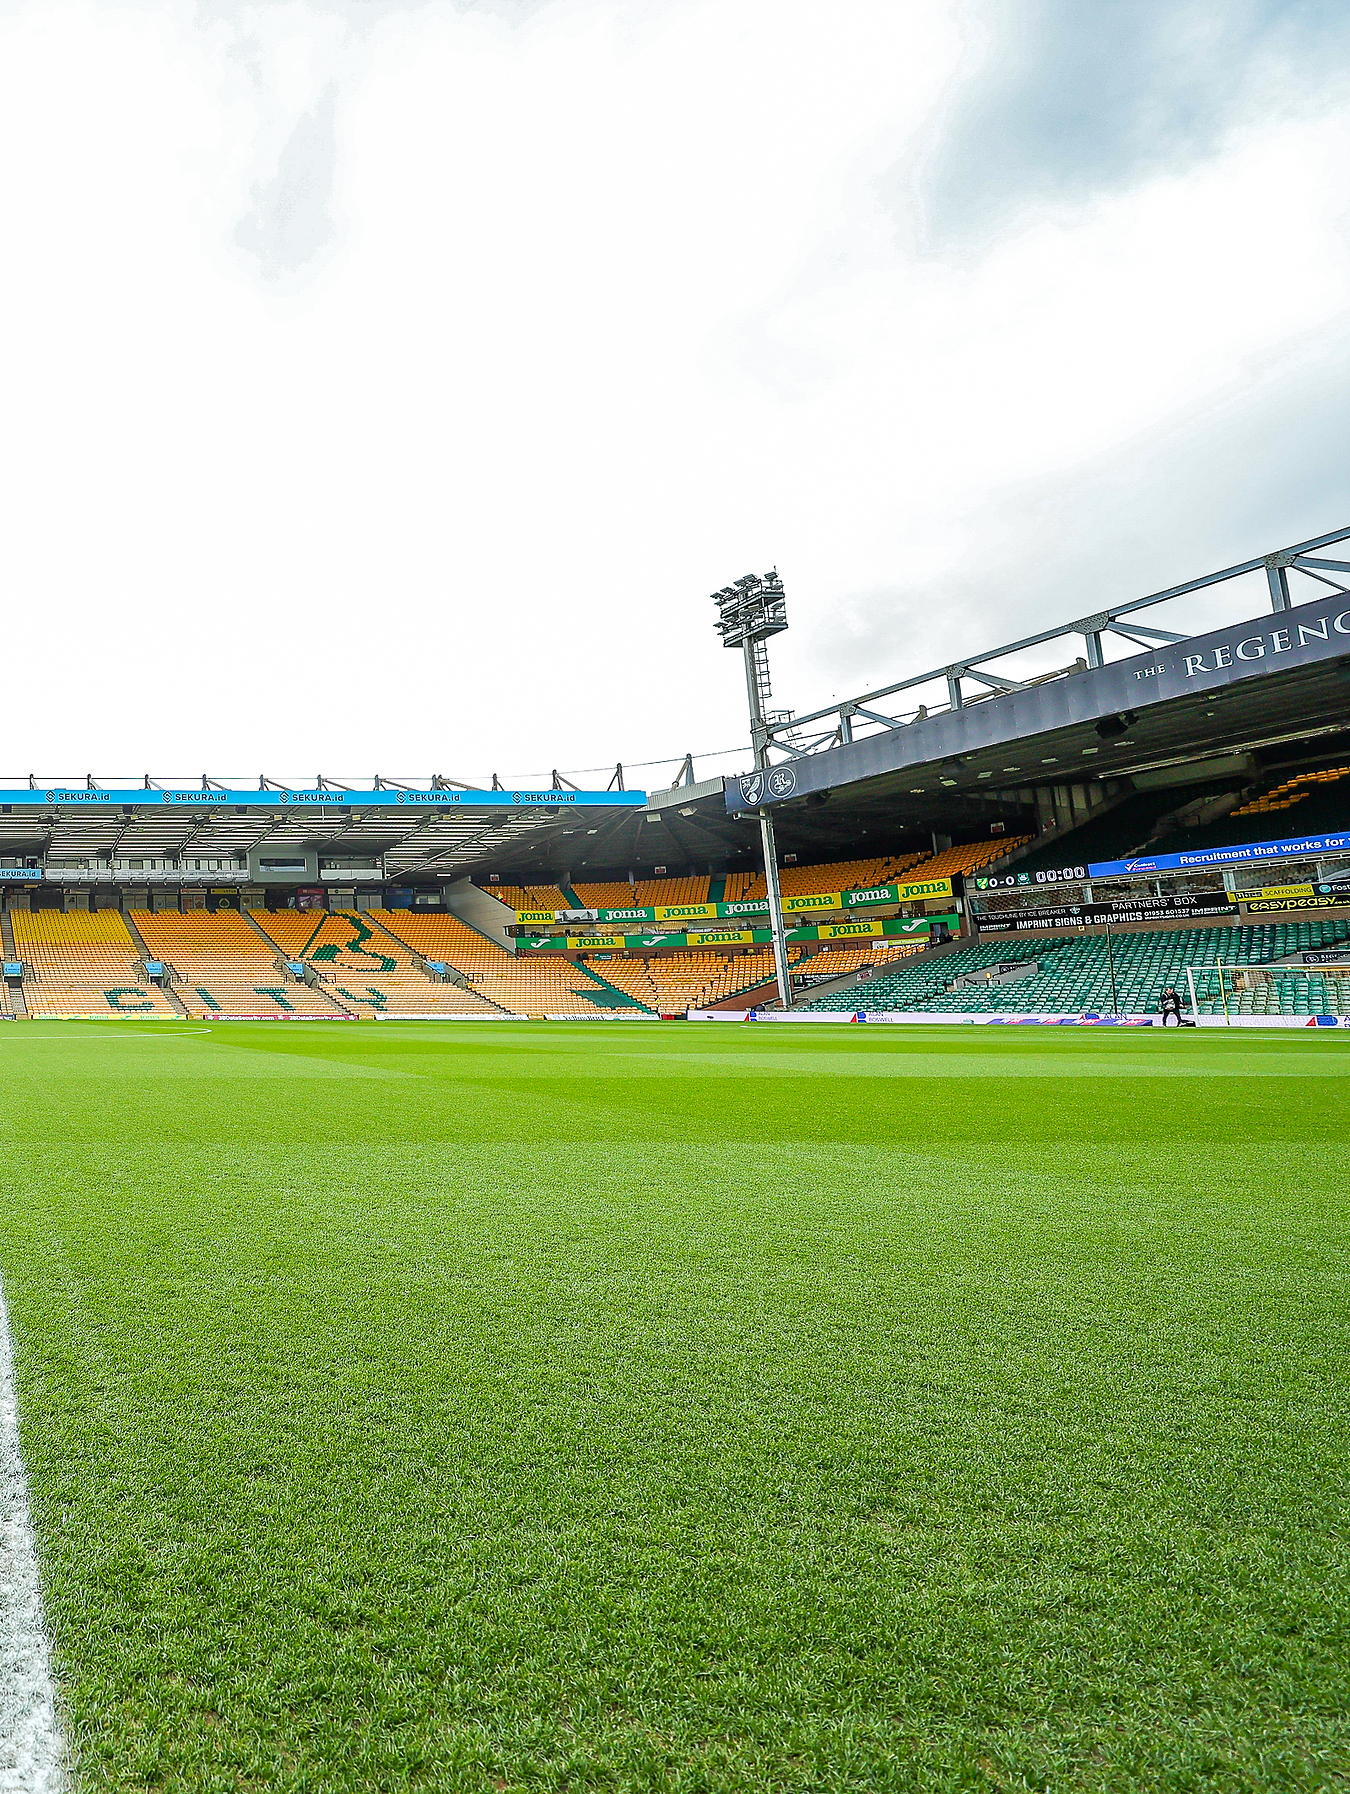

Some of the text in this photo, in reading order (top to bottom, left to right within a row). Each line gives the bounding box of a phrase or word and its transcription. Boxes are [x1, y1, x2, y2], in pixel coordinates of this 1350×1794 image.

[1132, 663, 1166, 680] THE
[58, 793, 110, 801] SEKURA.id
[175, 793, 227, 802] SEKURA.id
[292, 794, 344, 802] SEKURA.id
[408, 794, 460, 802] SEKURA.id
[524, 794, 576, 802] SEKURA.id
[1180, 838, 1345, 864] Recruitment that works for
[1036, 866, 1085, 883] 00:00
[1264, 887, 1312, 896] SCAFFOLDING
[1112, 896, 1198, 910] PARTNERS' BOX
[1016, 912, 1142, 930] IMPRINT SIGNS & GRAPHICS
[104, 988, 388, 1011] CITY
